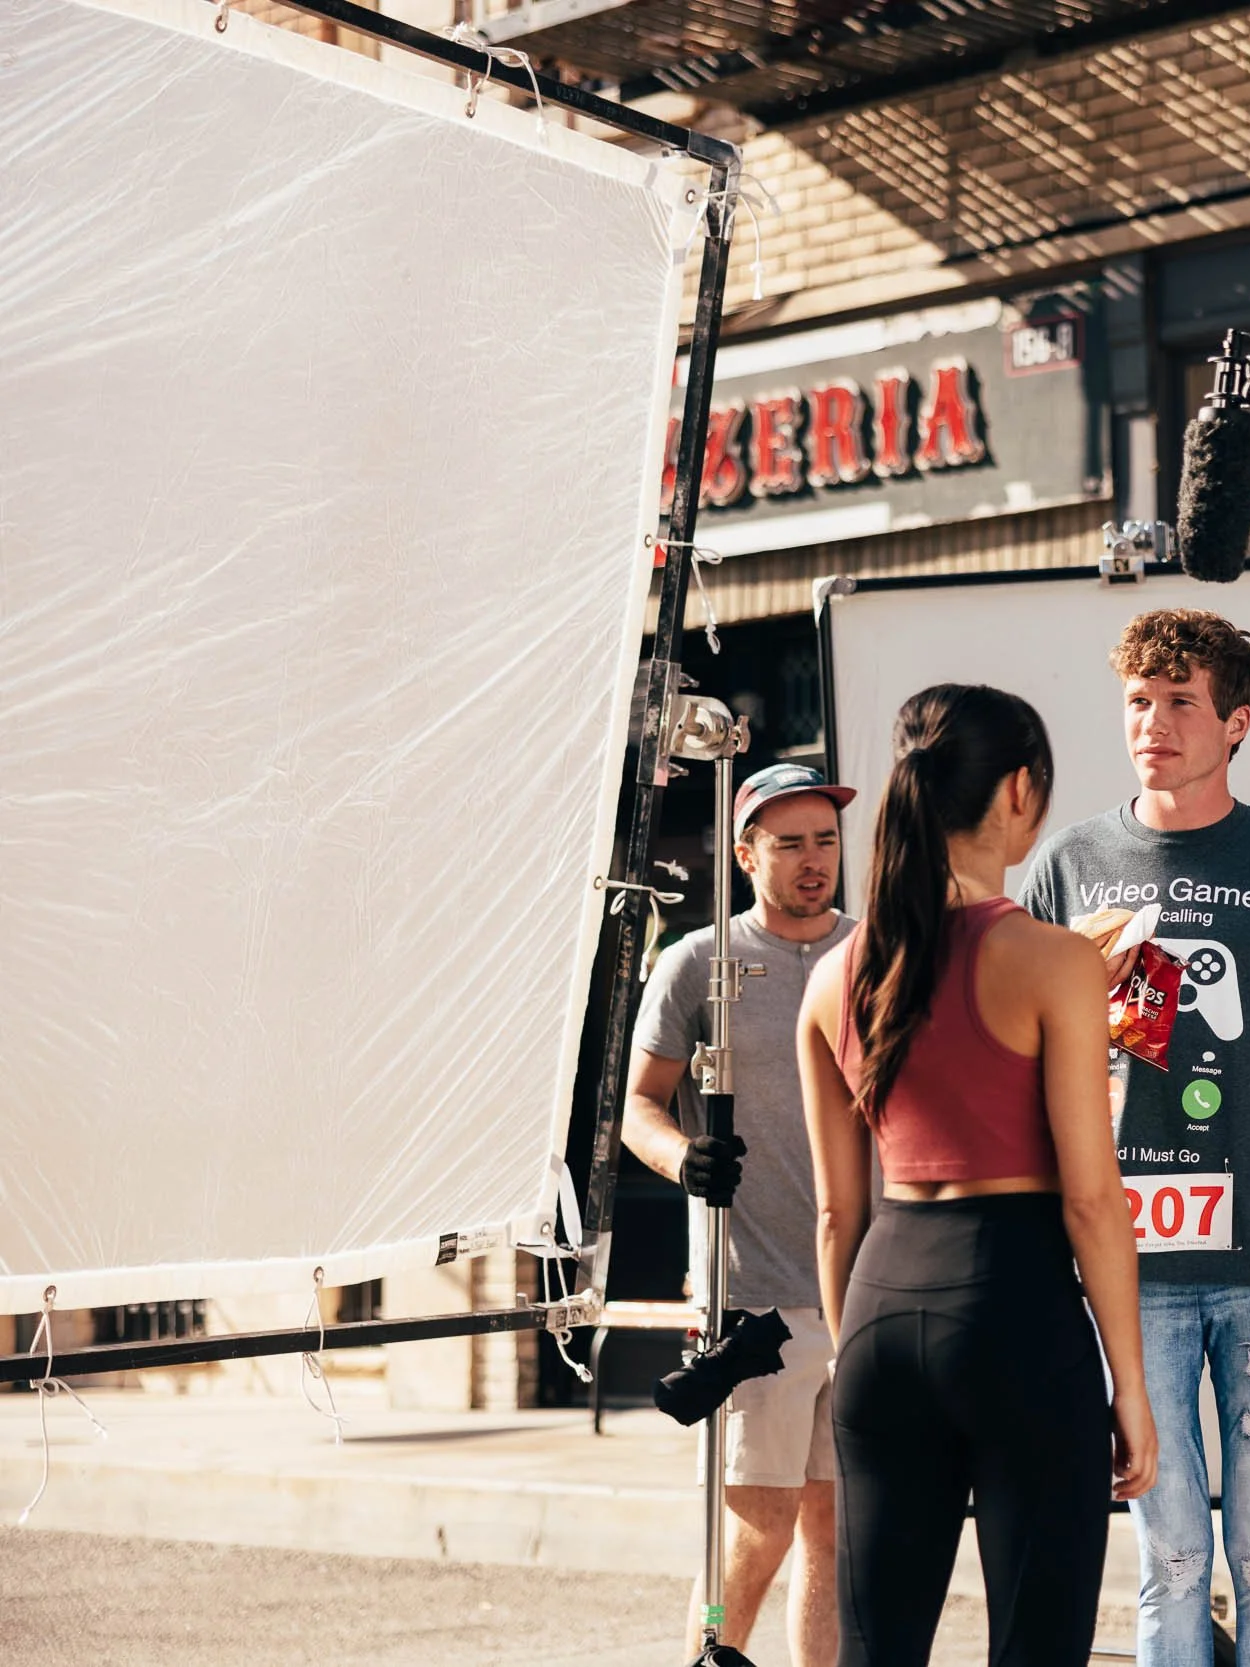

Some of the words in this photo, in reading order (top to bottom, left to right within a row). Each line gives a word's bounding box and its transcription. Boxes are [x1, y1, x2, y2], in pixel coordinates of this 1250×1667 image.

[1080, 880, 1158, 907] Video
[1160, 909, 1213, 927] calling
[1191, 1065, 1222, 1075] Message
[1187, 1123, 1210, 1132] Accept
[1132, 1147, 1136, 1160] I
[1140, 1148, 1175, 1162] Must
[1178, 1149, 1200, 1163] Go
